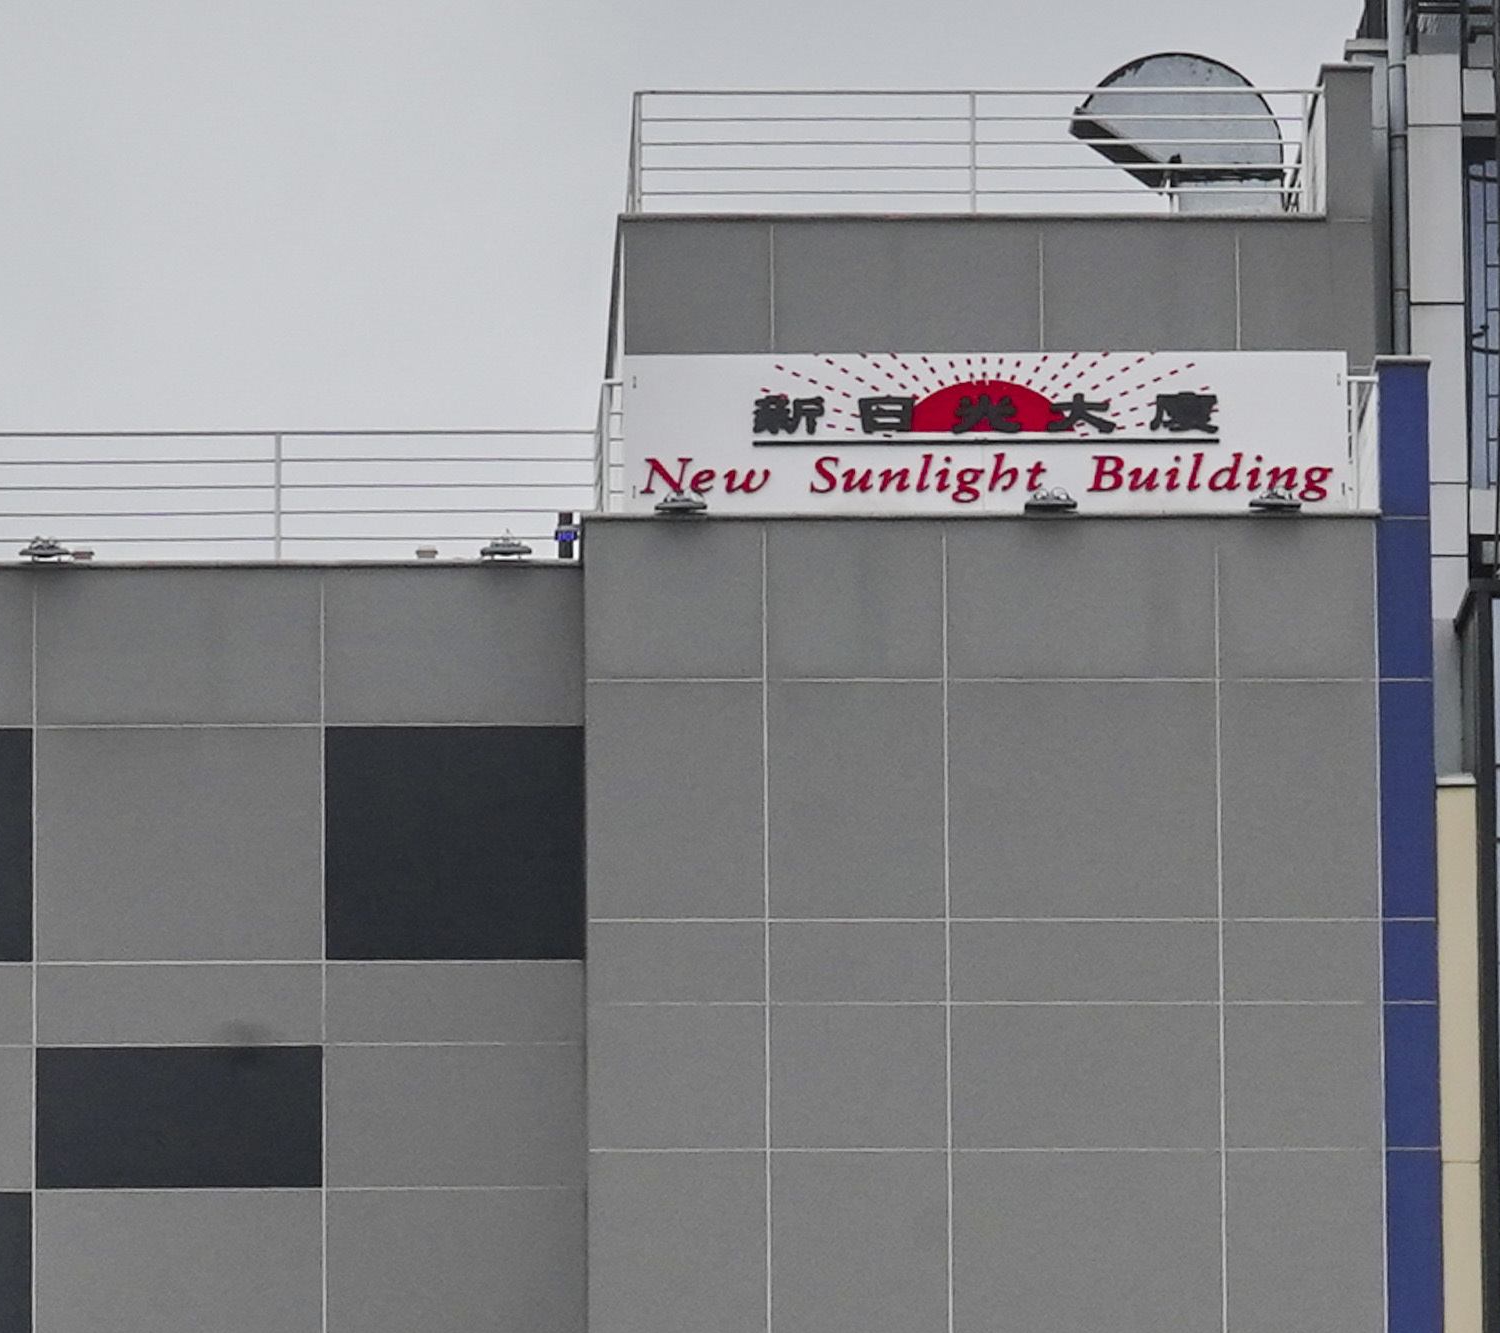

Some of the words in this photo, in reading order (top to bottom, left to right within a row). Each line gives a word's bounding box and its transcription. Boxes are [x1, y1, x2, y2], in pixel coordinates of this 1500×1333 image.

[641, 456, 772, 496] New
[810, 452, 1047, 505] Sunlight
[1087, 452, 1334, 503] Building
